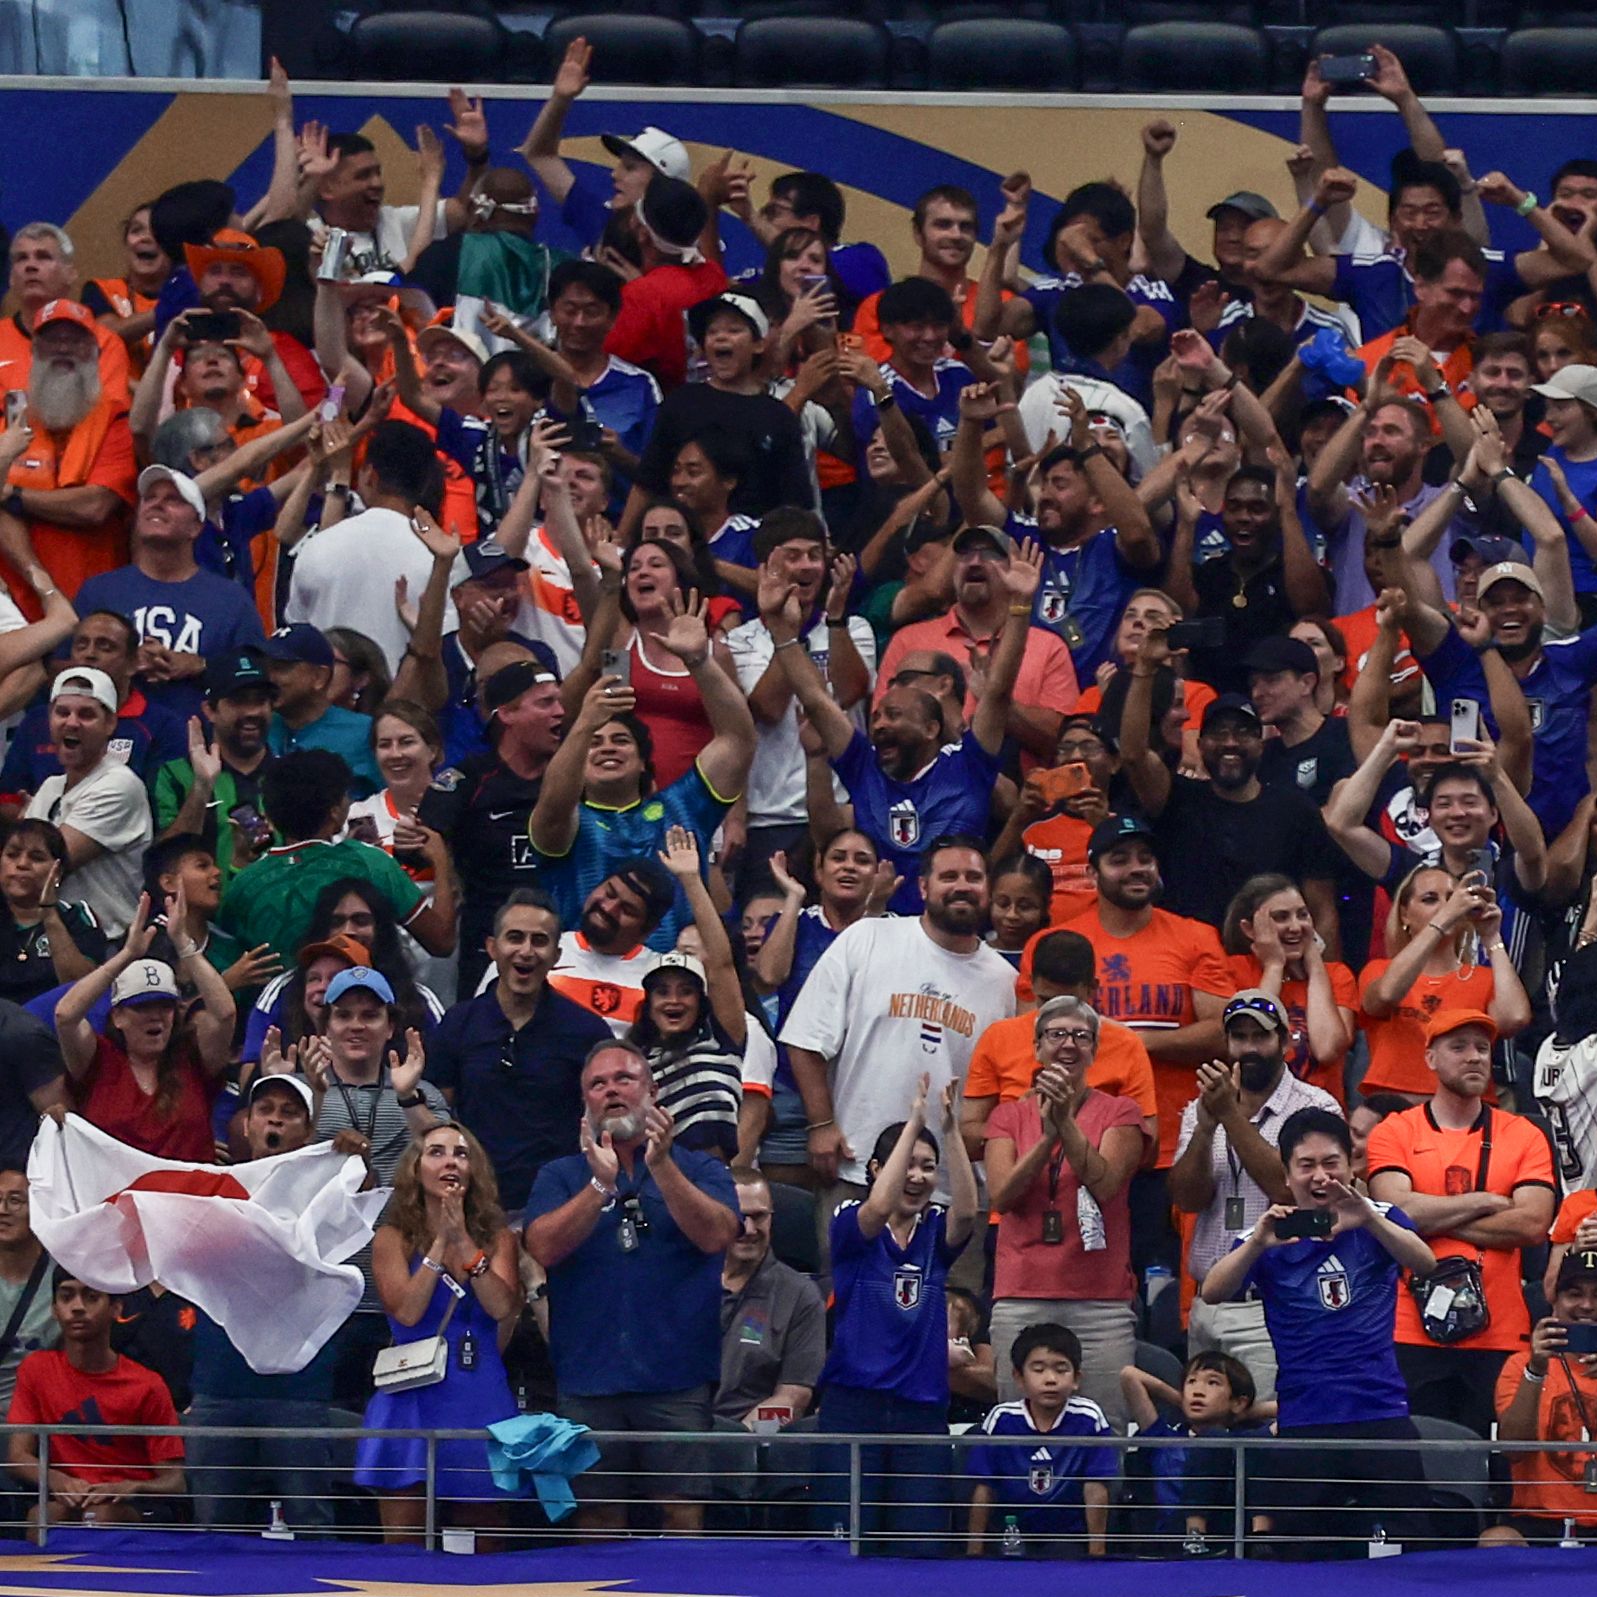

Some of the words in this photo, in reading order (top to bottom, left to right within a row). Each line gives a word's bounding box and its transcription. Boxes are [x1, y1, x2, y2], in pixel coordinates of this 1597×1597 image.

[144, 965, 161, 988] B
[889, 992, 977, 1040] NETHERLANDS
[1091, 984, 1185, 1019] ERLAND
